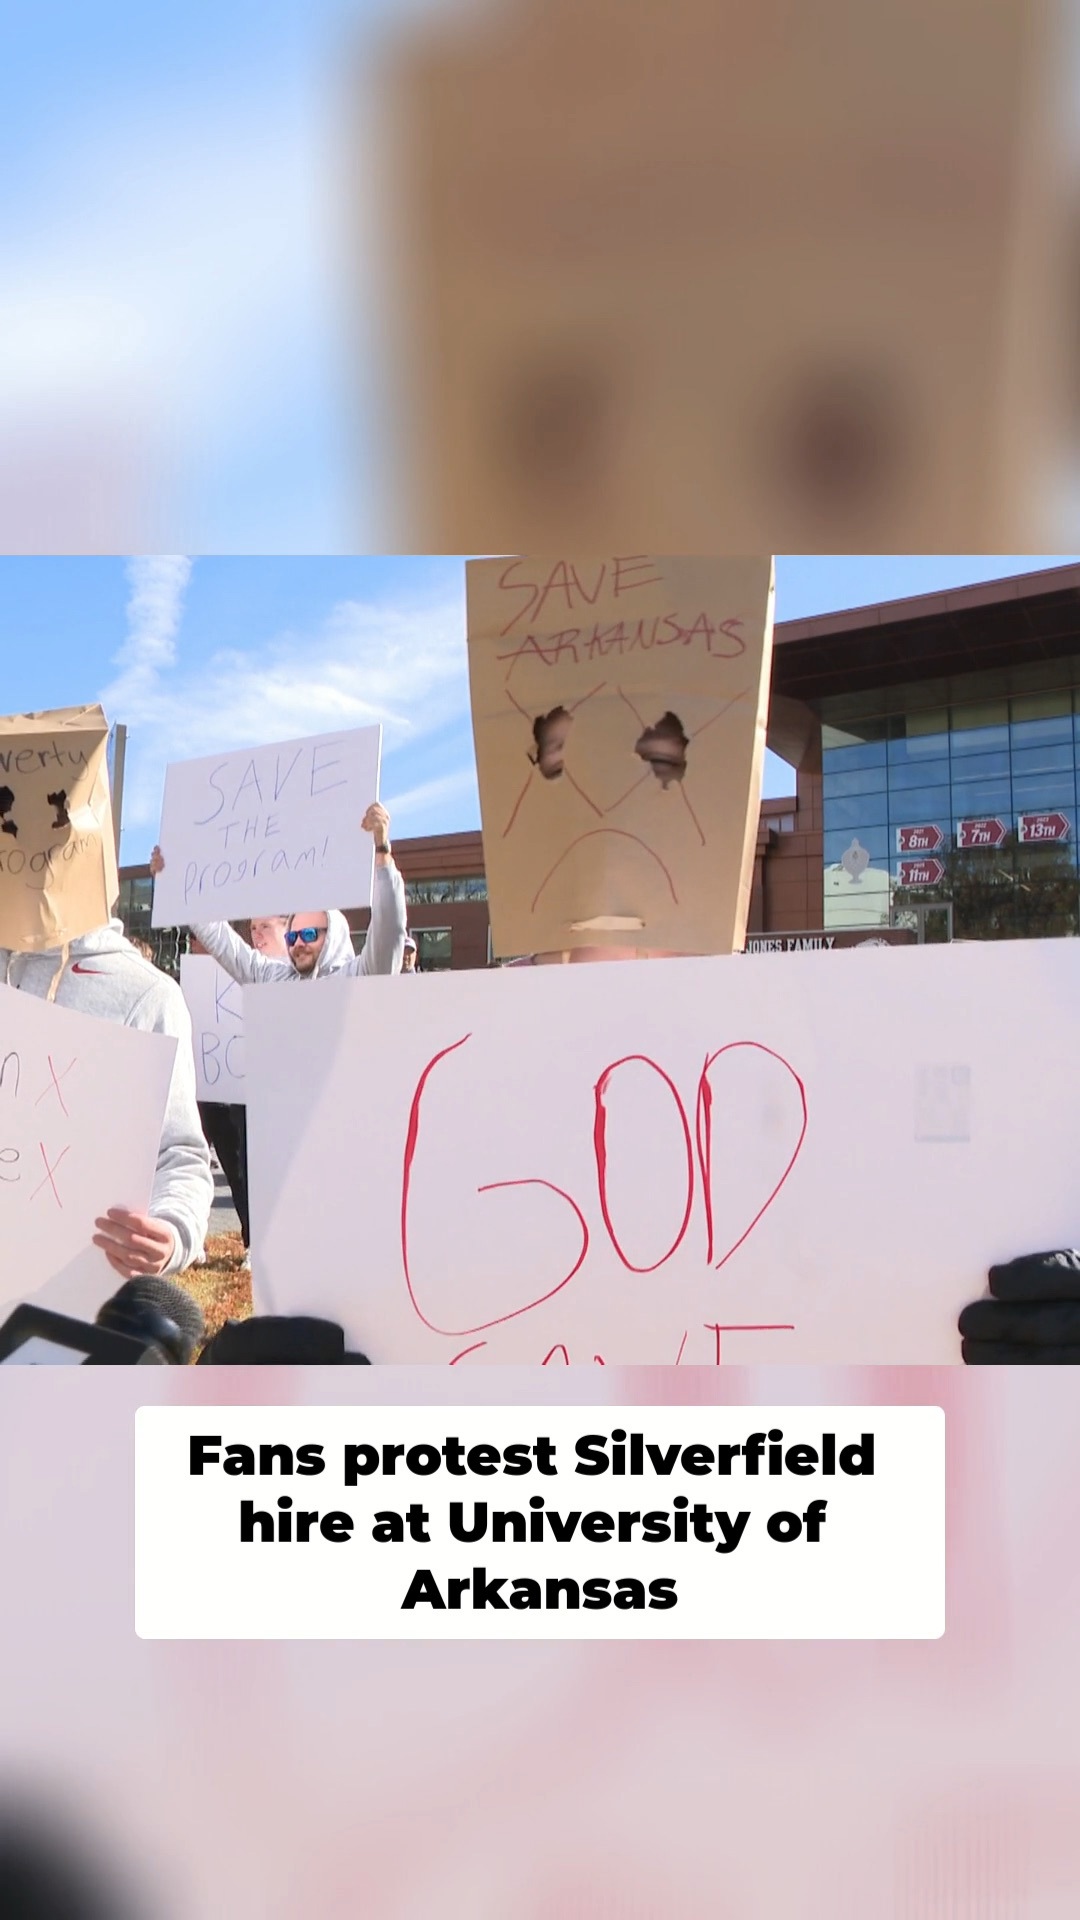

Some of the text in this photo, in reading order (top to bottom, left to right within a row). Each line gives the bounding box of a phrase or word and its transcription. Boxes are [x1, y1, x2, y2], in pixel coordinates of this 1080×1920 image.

[499, 555, 663, 636] SAVE
[497, 613, 746, 681] ARKANSAS
[194, 740, 348, 825] SAVE
[219, 815, 282, 849] THE
[908, 834, 929, 848] 8TH
[971, 830, 991, 844] 7TH
[1030, 824, 1056, 837] 13TH
[183, 835, 329, 904] program!
[908, 869, 930, 882] 11TH
[746, 936, 835, 954] JONES FAMILY
[401, 1033, 807, 1335] GOD
